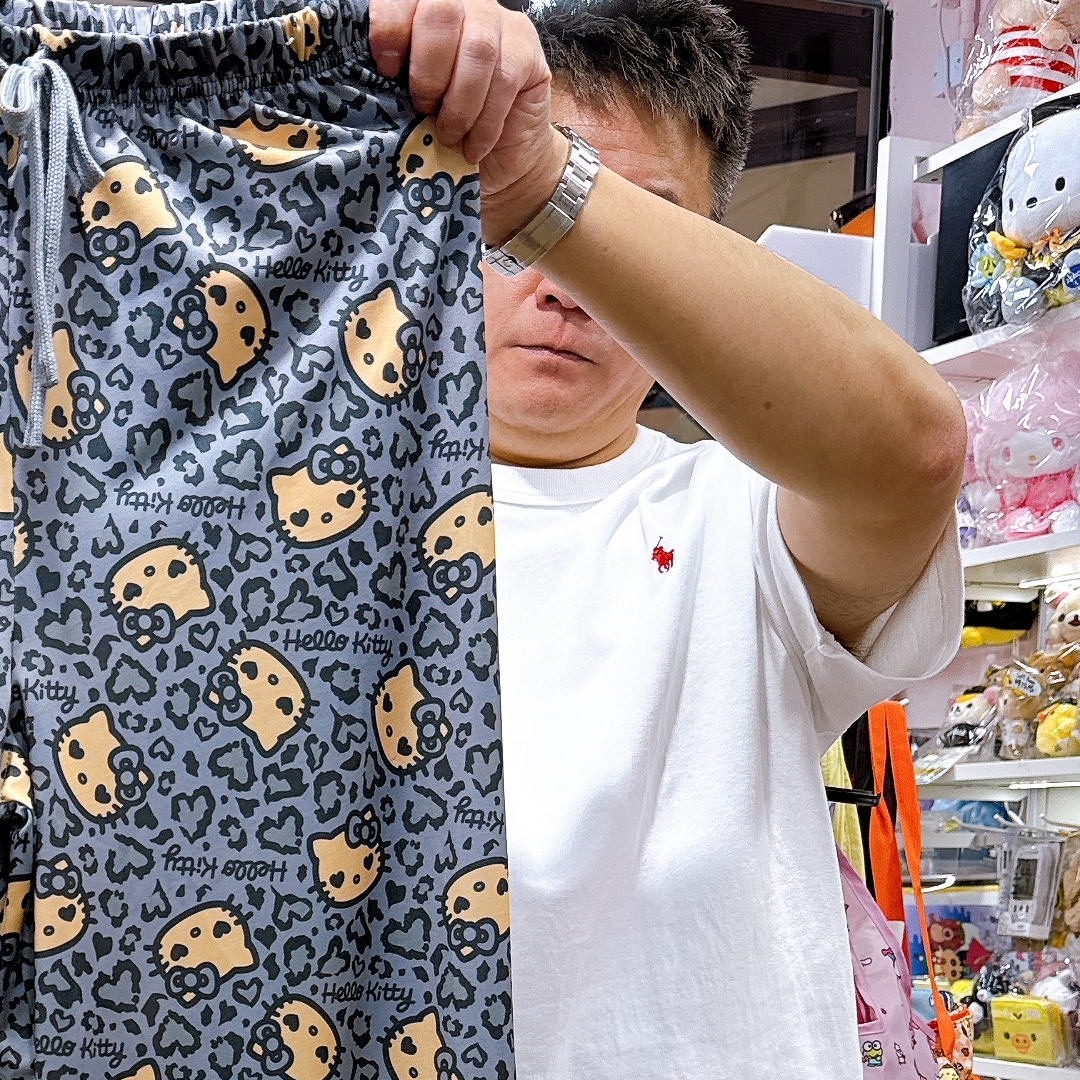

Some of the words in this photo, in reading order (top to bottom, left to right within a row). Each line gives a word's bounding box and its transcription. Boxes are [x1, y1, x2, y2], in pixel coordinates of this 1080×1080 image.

[139, 126, 200, 149] Hello
[253, 257, 312, 281] Hello
[313, 257, 369, 294] Kitty
[428, 434, 484, 462] Kitty
[114, 481, 174, 515] Kitty
[178, 494, 246, 519] Hello
[283, 629, 350, 653] Hello
[351, 629, 395, 662] Kitty
[22, 677, 79, 711] Kitty
[453, 797, 504, 831] Kitty
[162, 845, 218, 879] Kitty
[221, 860, 288, 882] Hello
[322, 981, 366, 1004] Hello
[365, 982, 415, 1011] Kitty
[34, 1036, 77, 1057] ello
[80, 1036, 127, 1067] Kitty
